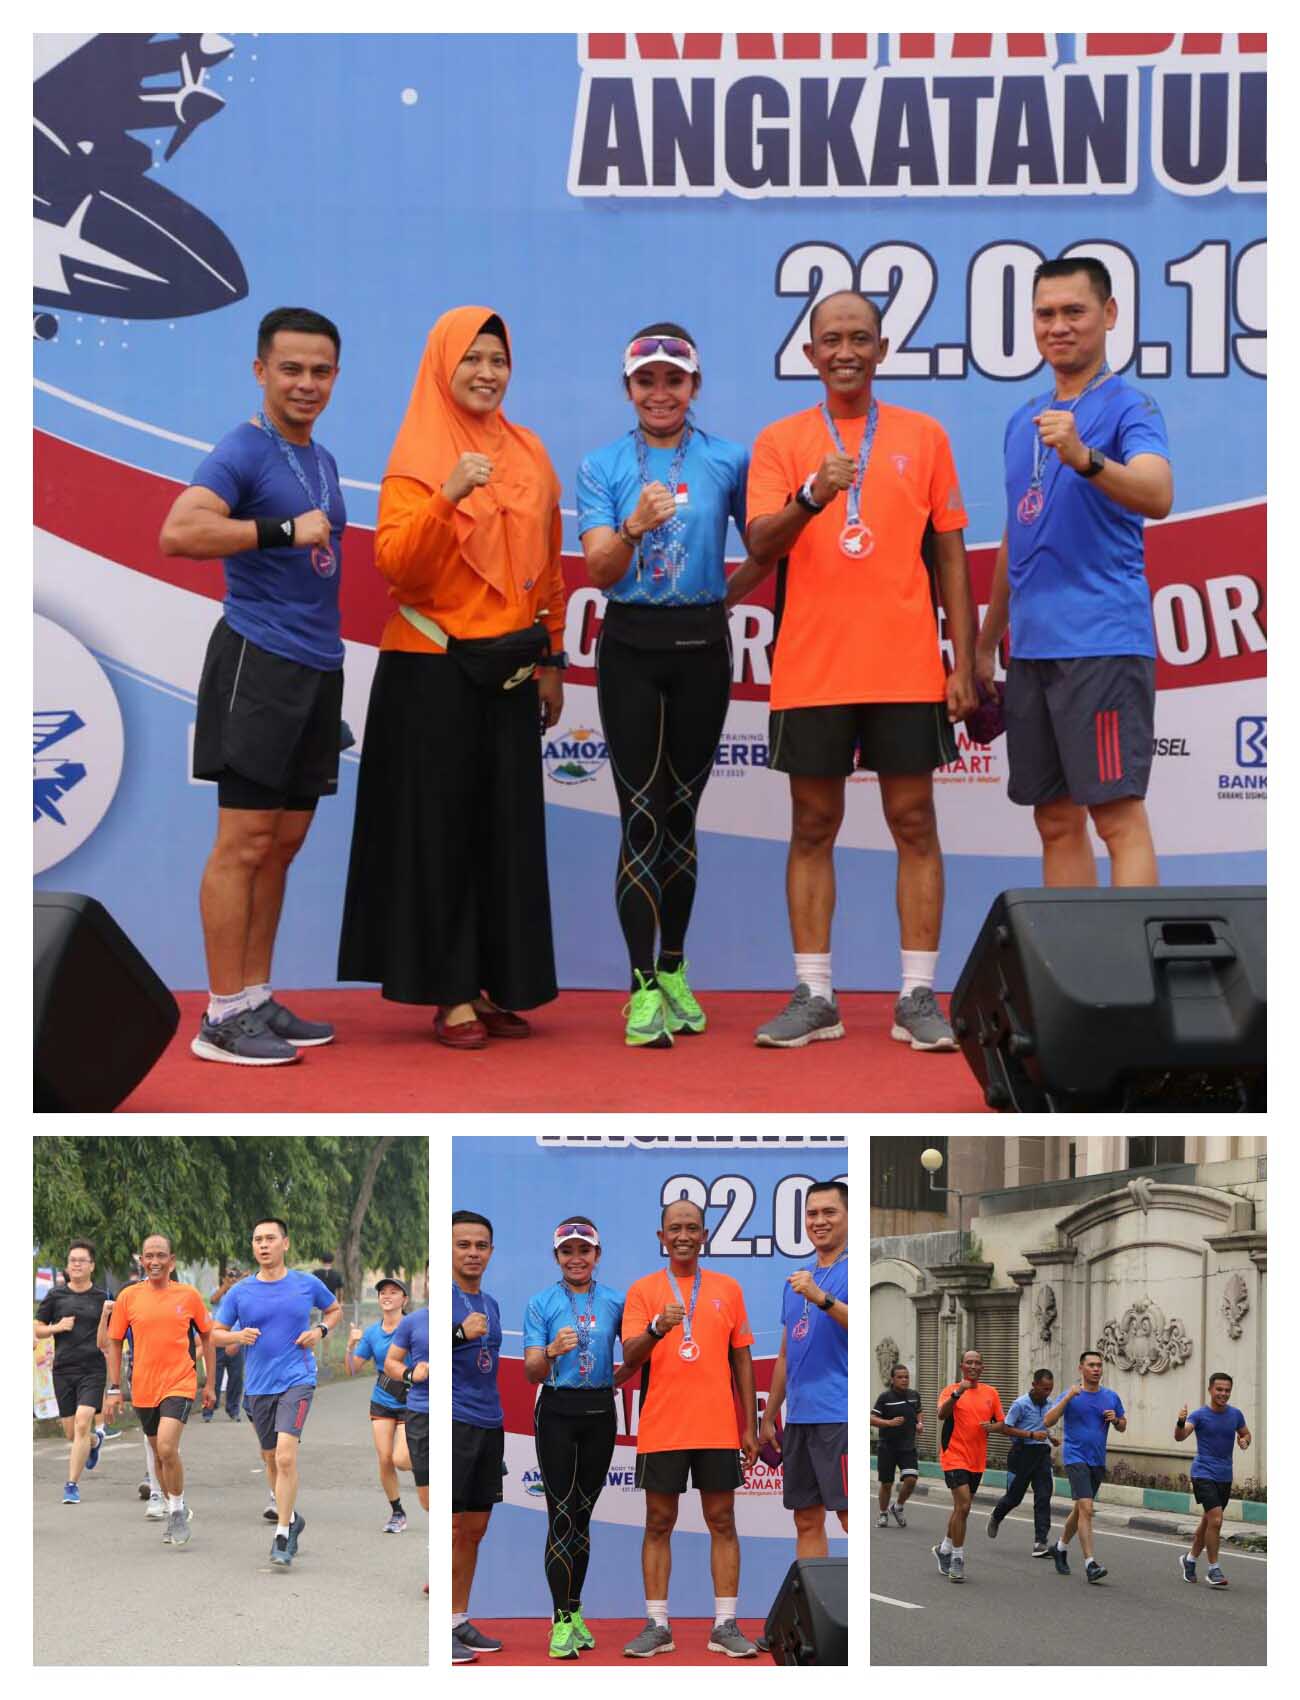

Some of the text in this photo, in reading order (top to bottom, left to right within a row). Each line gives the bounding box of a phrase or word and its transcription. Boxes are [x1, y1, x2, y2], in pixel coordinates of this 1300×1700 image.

[578, 75, 1127, 190] ANGKATAN
[1152, 576, 1267, 666] OR
[543, 741, 609, 760] AMOZ
[714, 744, 769, 766] ERB
[1218, 775, 1267, 789] BANK
[744, 1477, 783, 1489] SMAR
